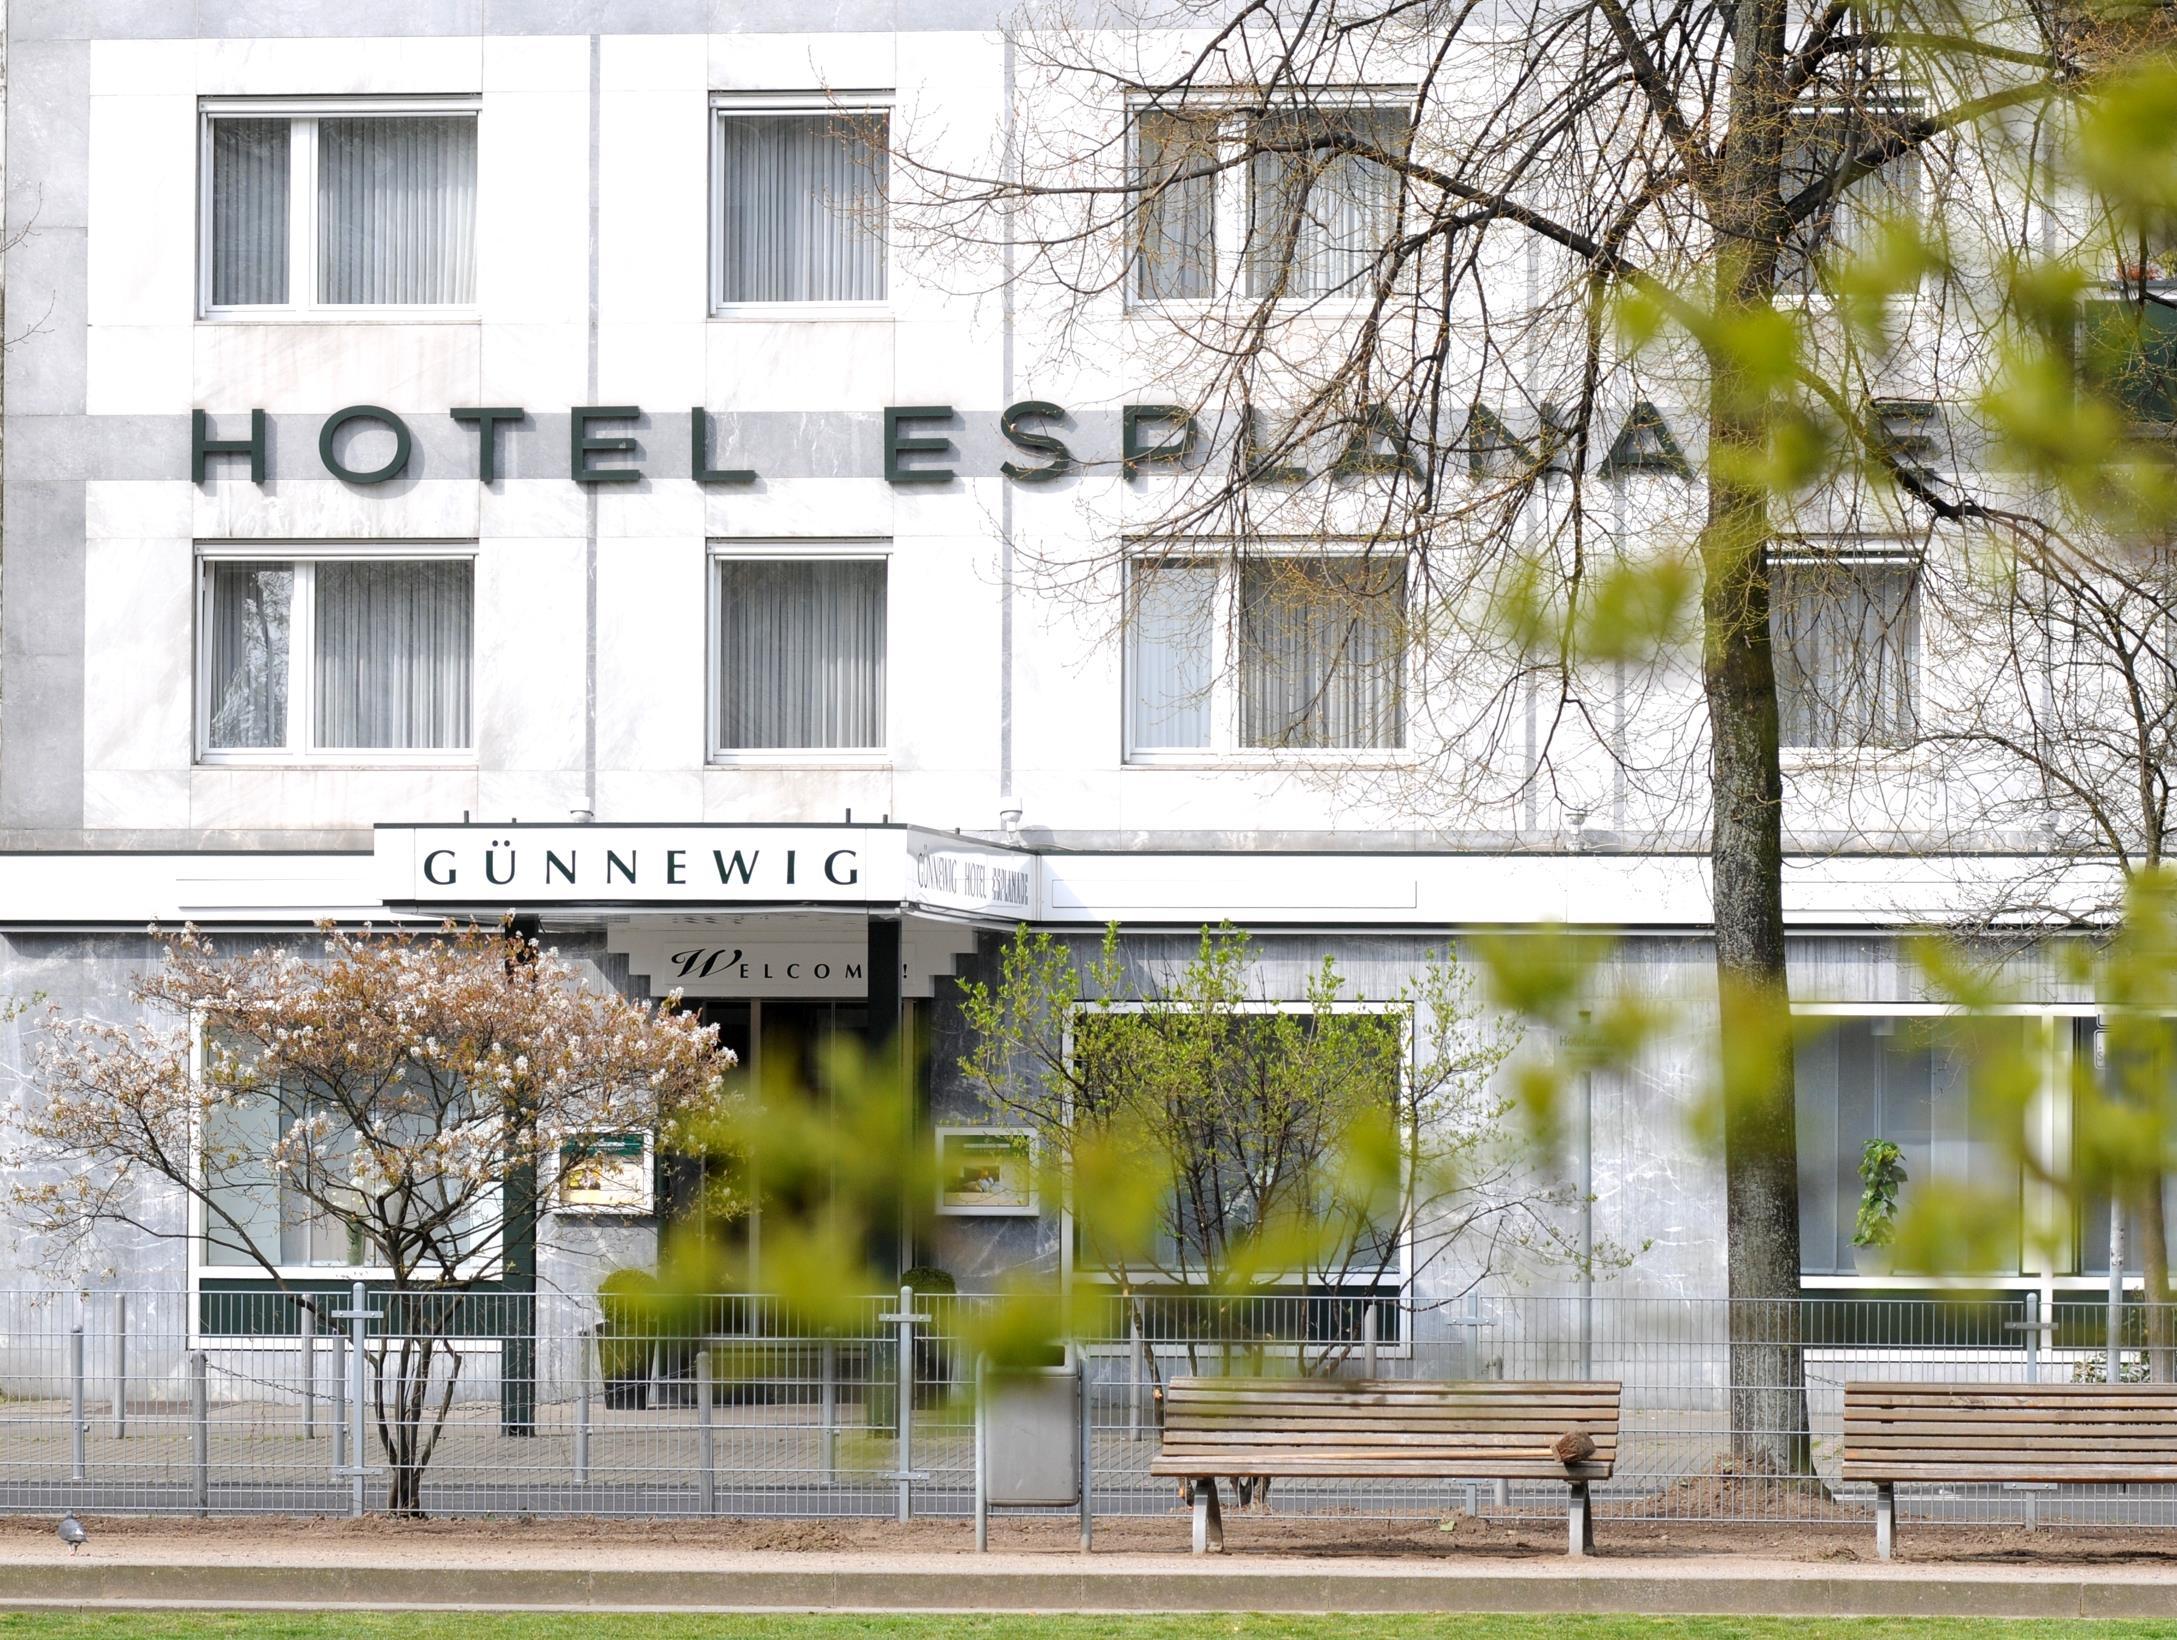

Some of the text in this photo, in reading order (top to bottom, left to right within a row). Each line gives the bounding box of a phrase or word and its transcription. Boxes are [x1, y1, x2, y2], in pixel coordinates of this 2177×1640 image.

[192, 400, 1936, 485] HOTEL ESPLANAE
[423, 839, 859, 887] GÜNNEWIG
[917, 843, 1029, 906] GÜNNEWIG HOTEL ESPLANADE
[671, 948, 908, 979] WELCOM!
